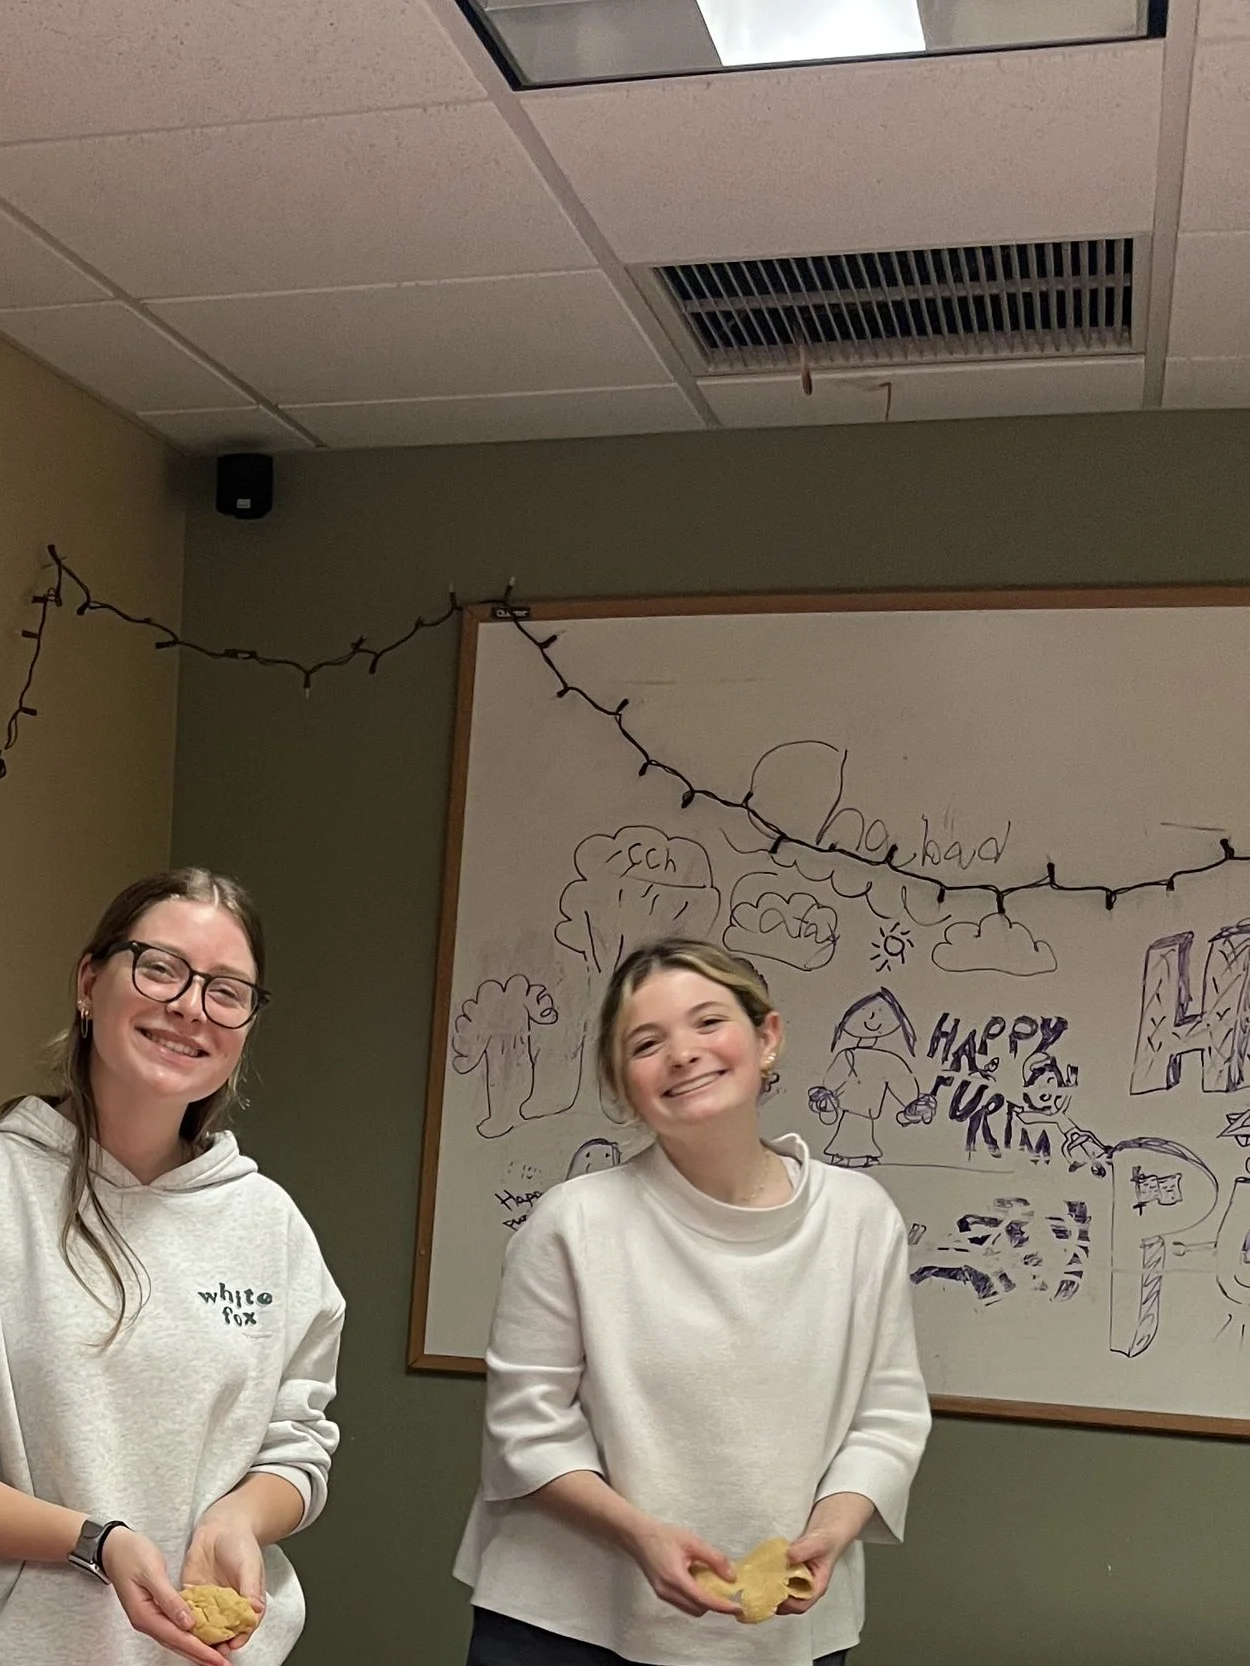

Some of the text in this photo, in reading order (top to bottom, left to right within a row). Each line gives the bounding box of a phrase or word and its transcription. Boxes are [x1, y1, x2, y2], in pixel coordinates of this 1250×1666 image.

[927, 1012, 1068, 1073] HAPPY
[197, 1282, 273, 1308] white
[222, 1306, 257, 1327] fox
